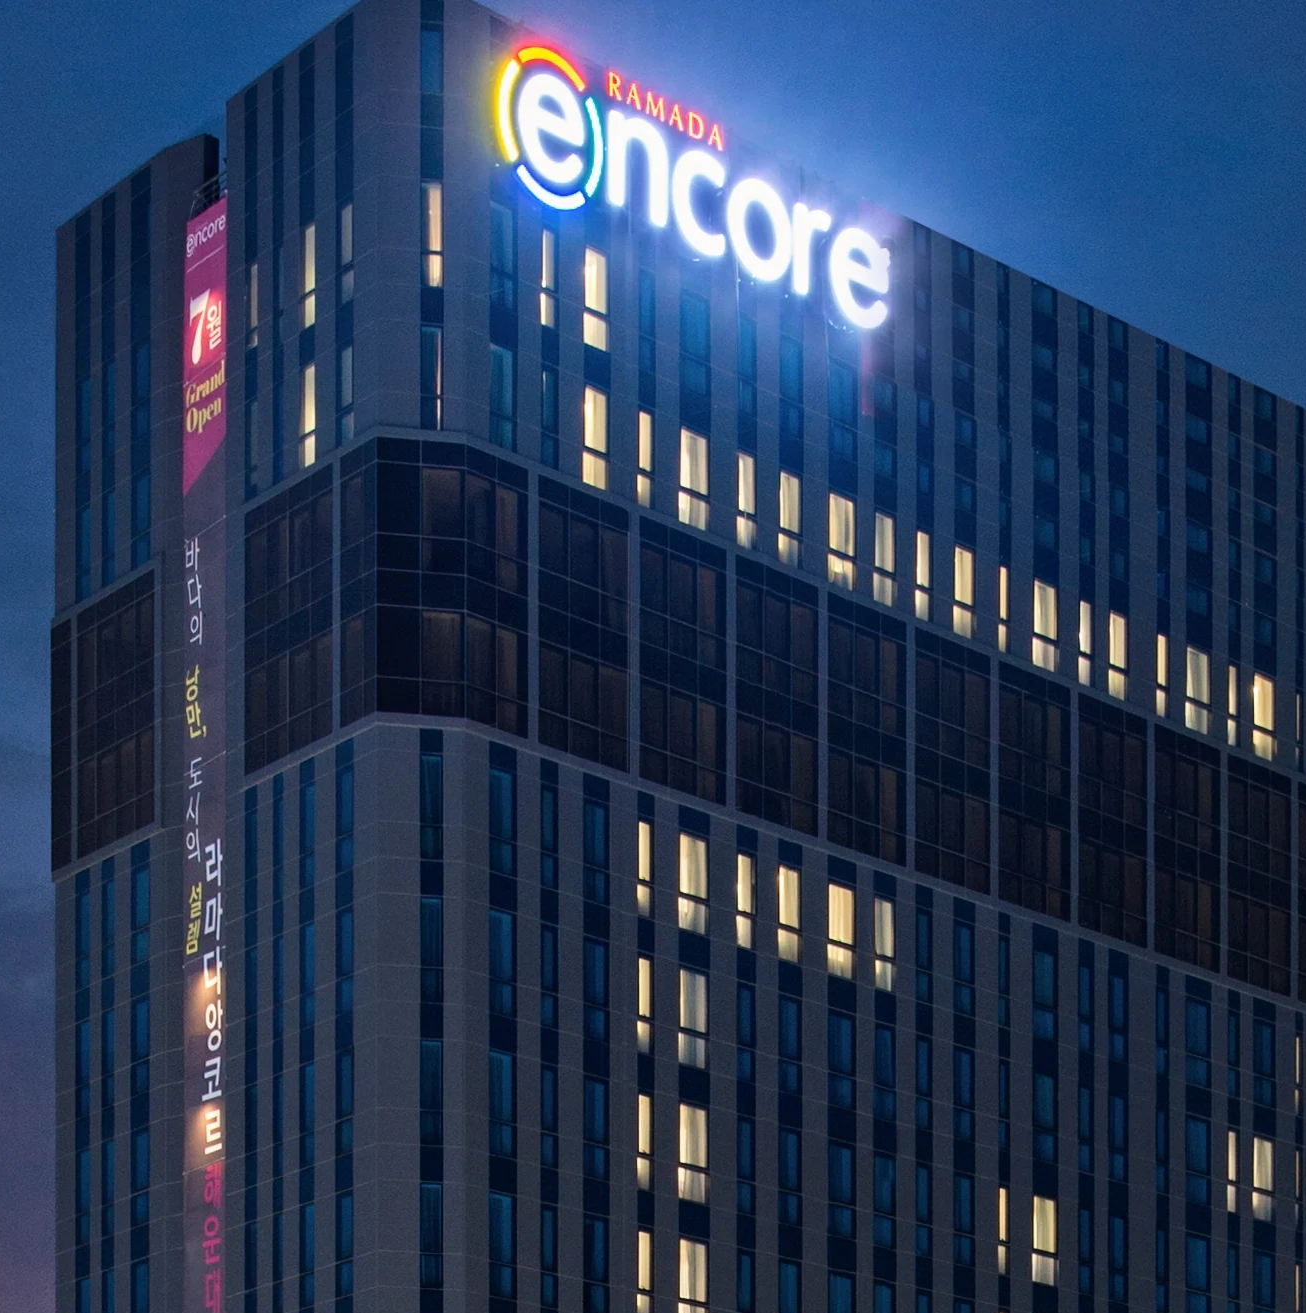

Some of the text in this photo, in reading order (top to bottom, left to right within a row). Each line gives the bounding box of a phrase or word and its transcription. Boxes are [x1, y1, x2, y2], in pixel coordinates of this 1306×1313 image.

[607, 71, 725, 151] RAMADA
[186, 215, 227, 257] encore
[514, 70, 891, 330] encore
[189, 288, 222, 365] 7월
[186, 358, 226, 406] Grand
[187, 396, 222, 435] Open
[185, 536, 203, 646] 바다의
[185, 756, 203, 862] 도시의
